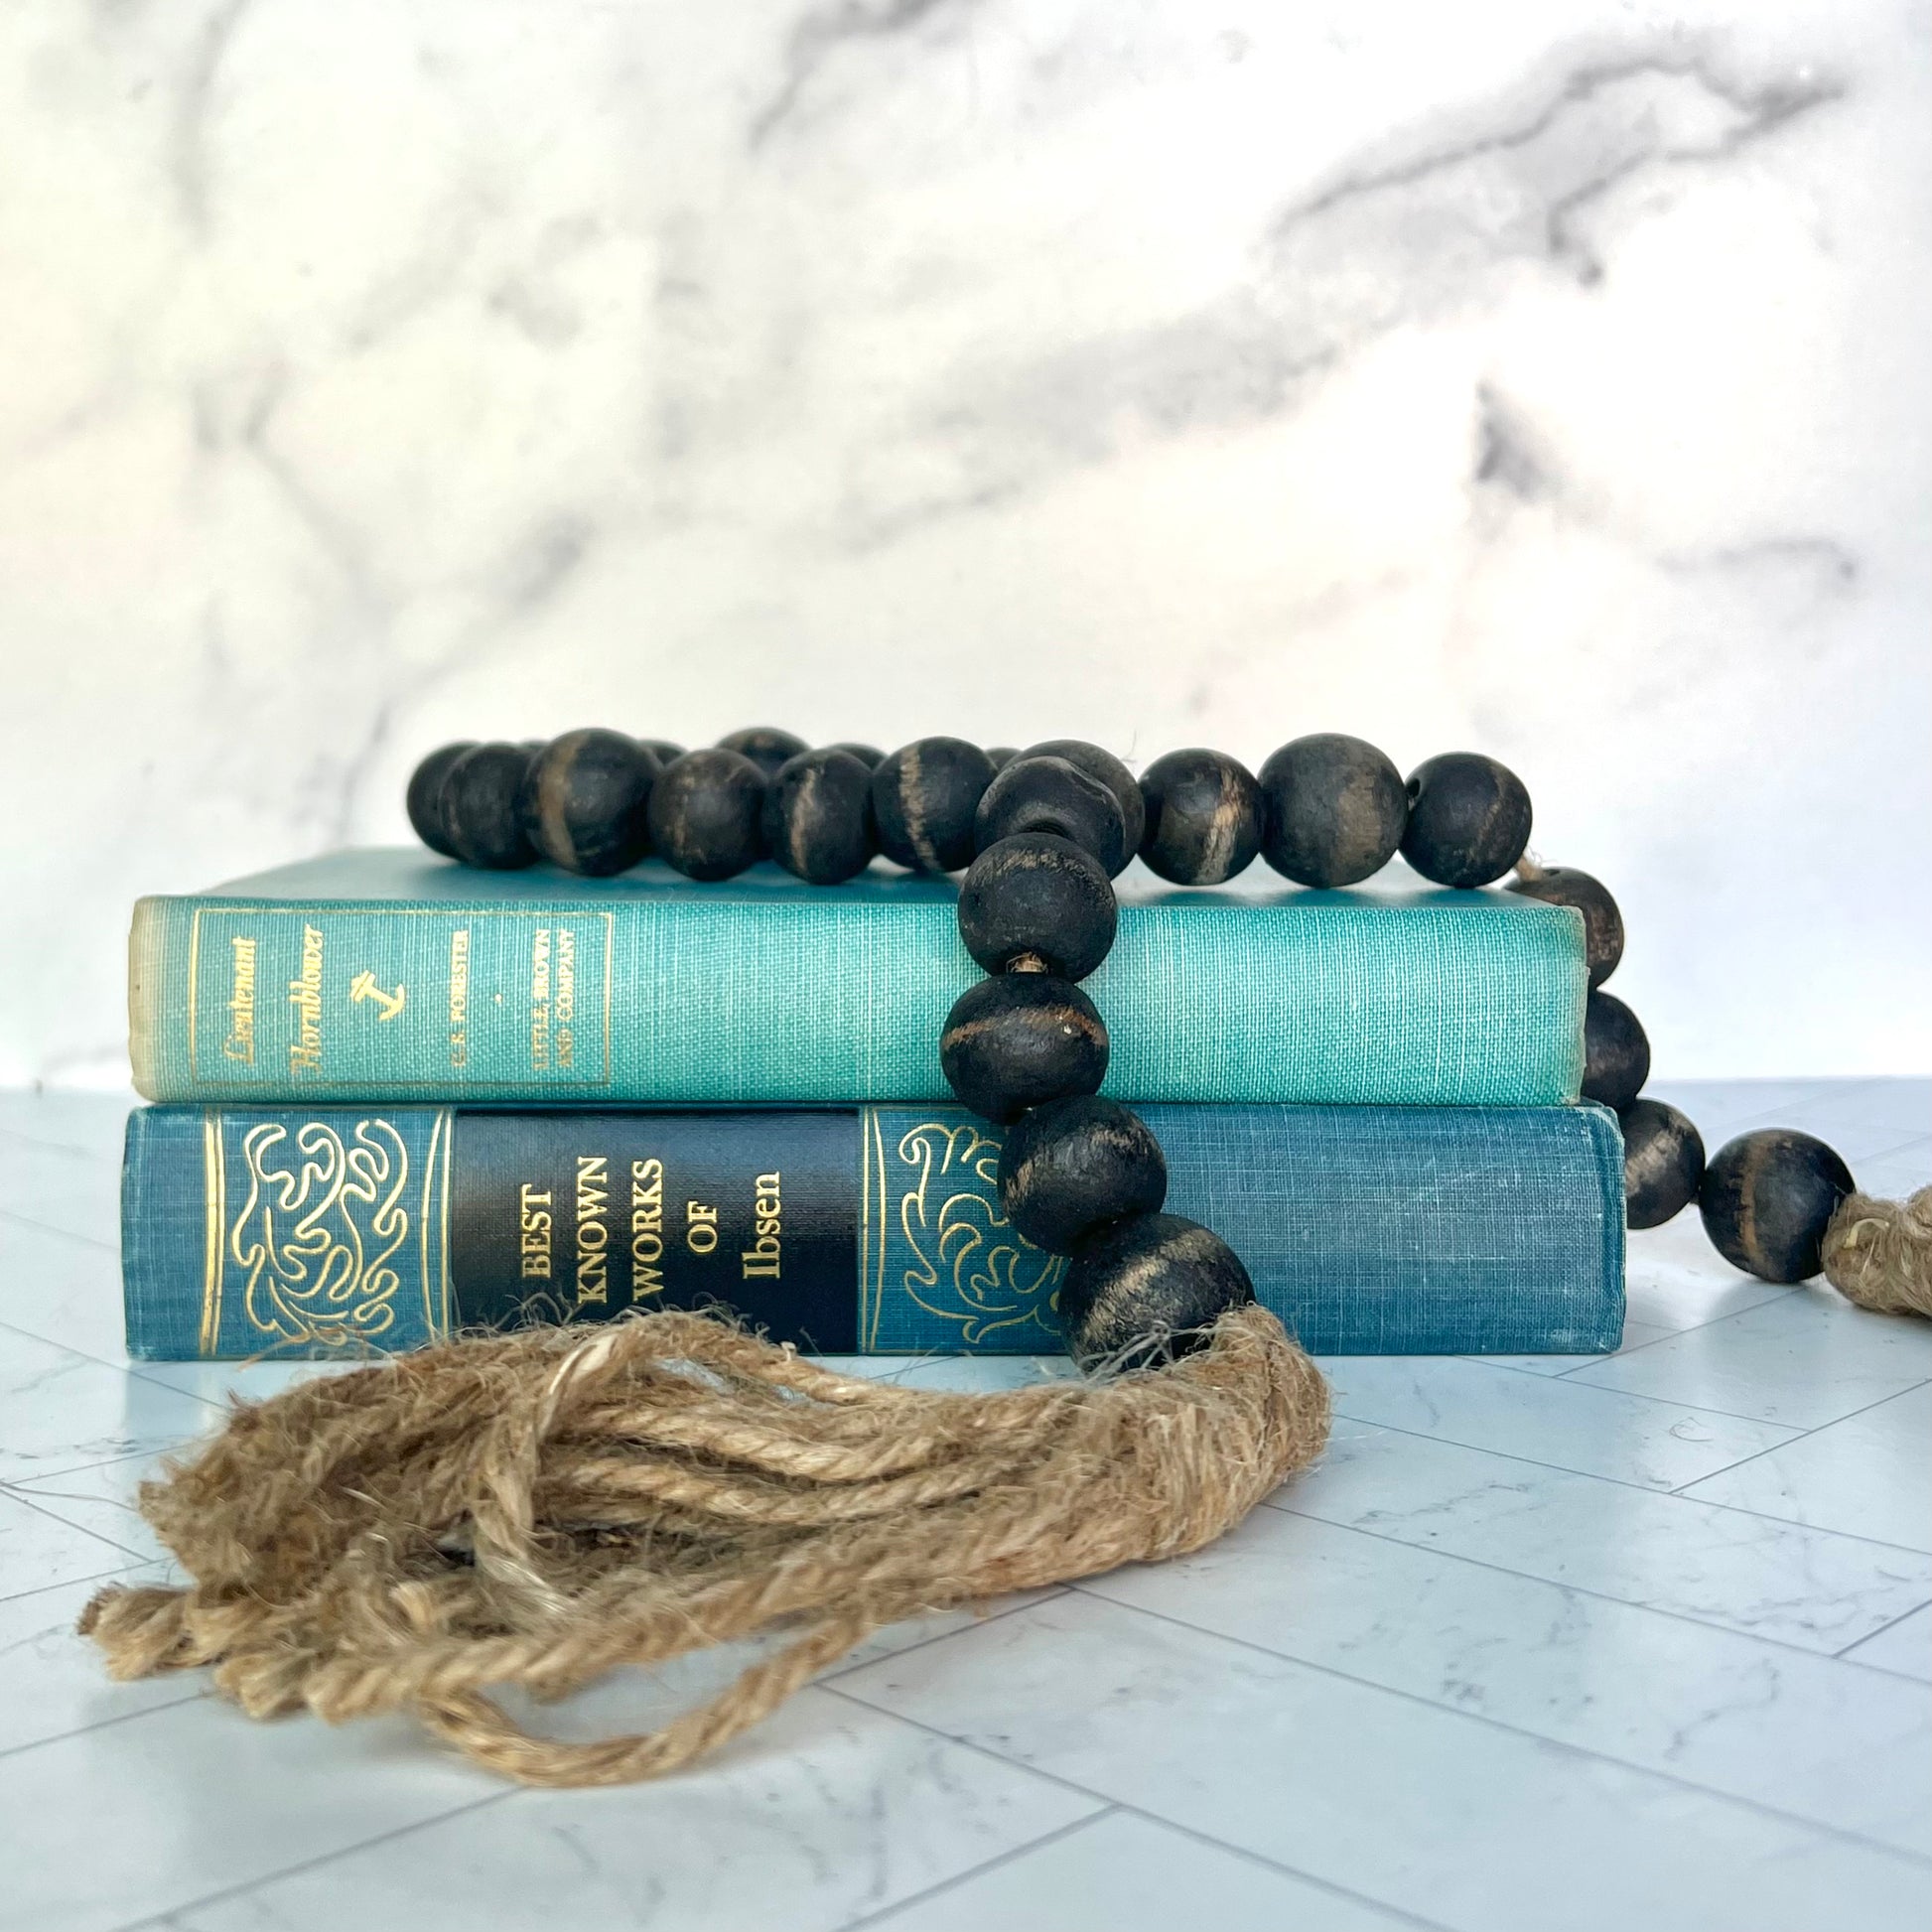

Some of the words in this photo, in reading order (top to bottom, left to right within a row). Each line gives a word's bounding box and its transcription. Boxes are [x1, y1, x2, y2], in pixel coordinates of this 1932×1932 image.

[224, 936, 255, 1065] Lieutenant
[290, 924, 323, 1075] Hornblower
[451, 929, 469, 1022] FORESTER
[533, 929, 550, 999] BROWN
[557, 928, 574, 1022] COMPANY
[532, 1004, 550, 1070] LITTLE,
[557, 1029, 573, 1067] AND
[521, 1183, 552, 1279] BEST
[577, 1157, 608, 1304] KNOWN
[631, 1158, 664, 1303] WORKS
[687, 1200, 718, 1253] OF
[742, 1171, 781, 1279] Ibsen
